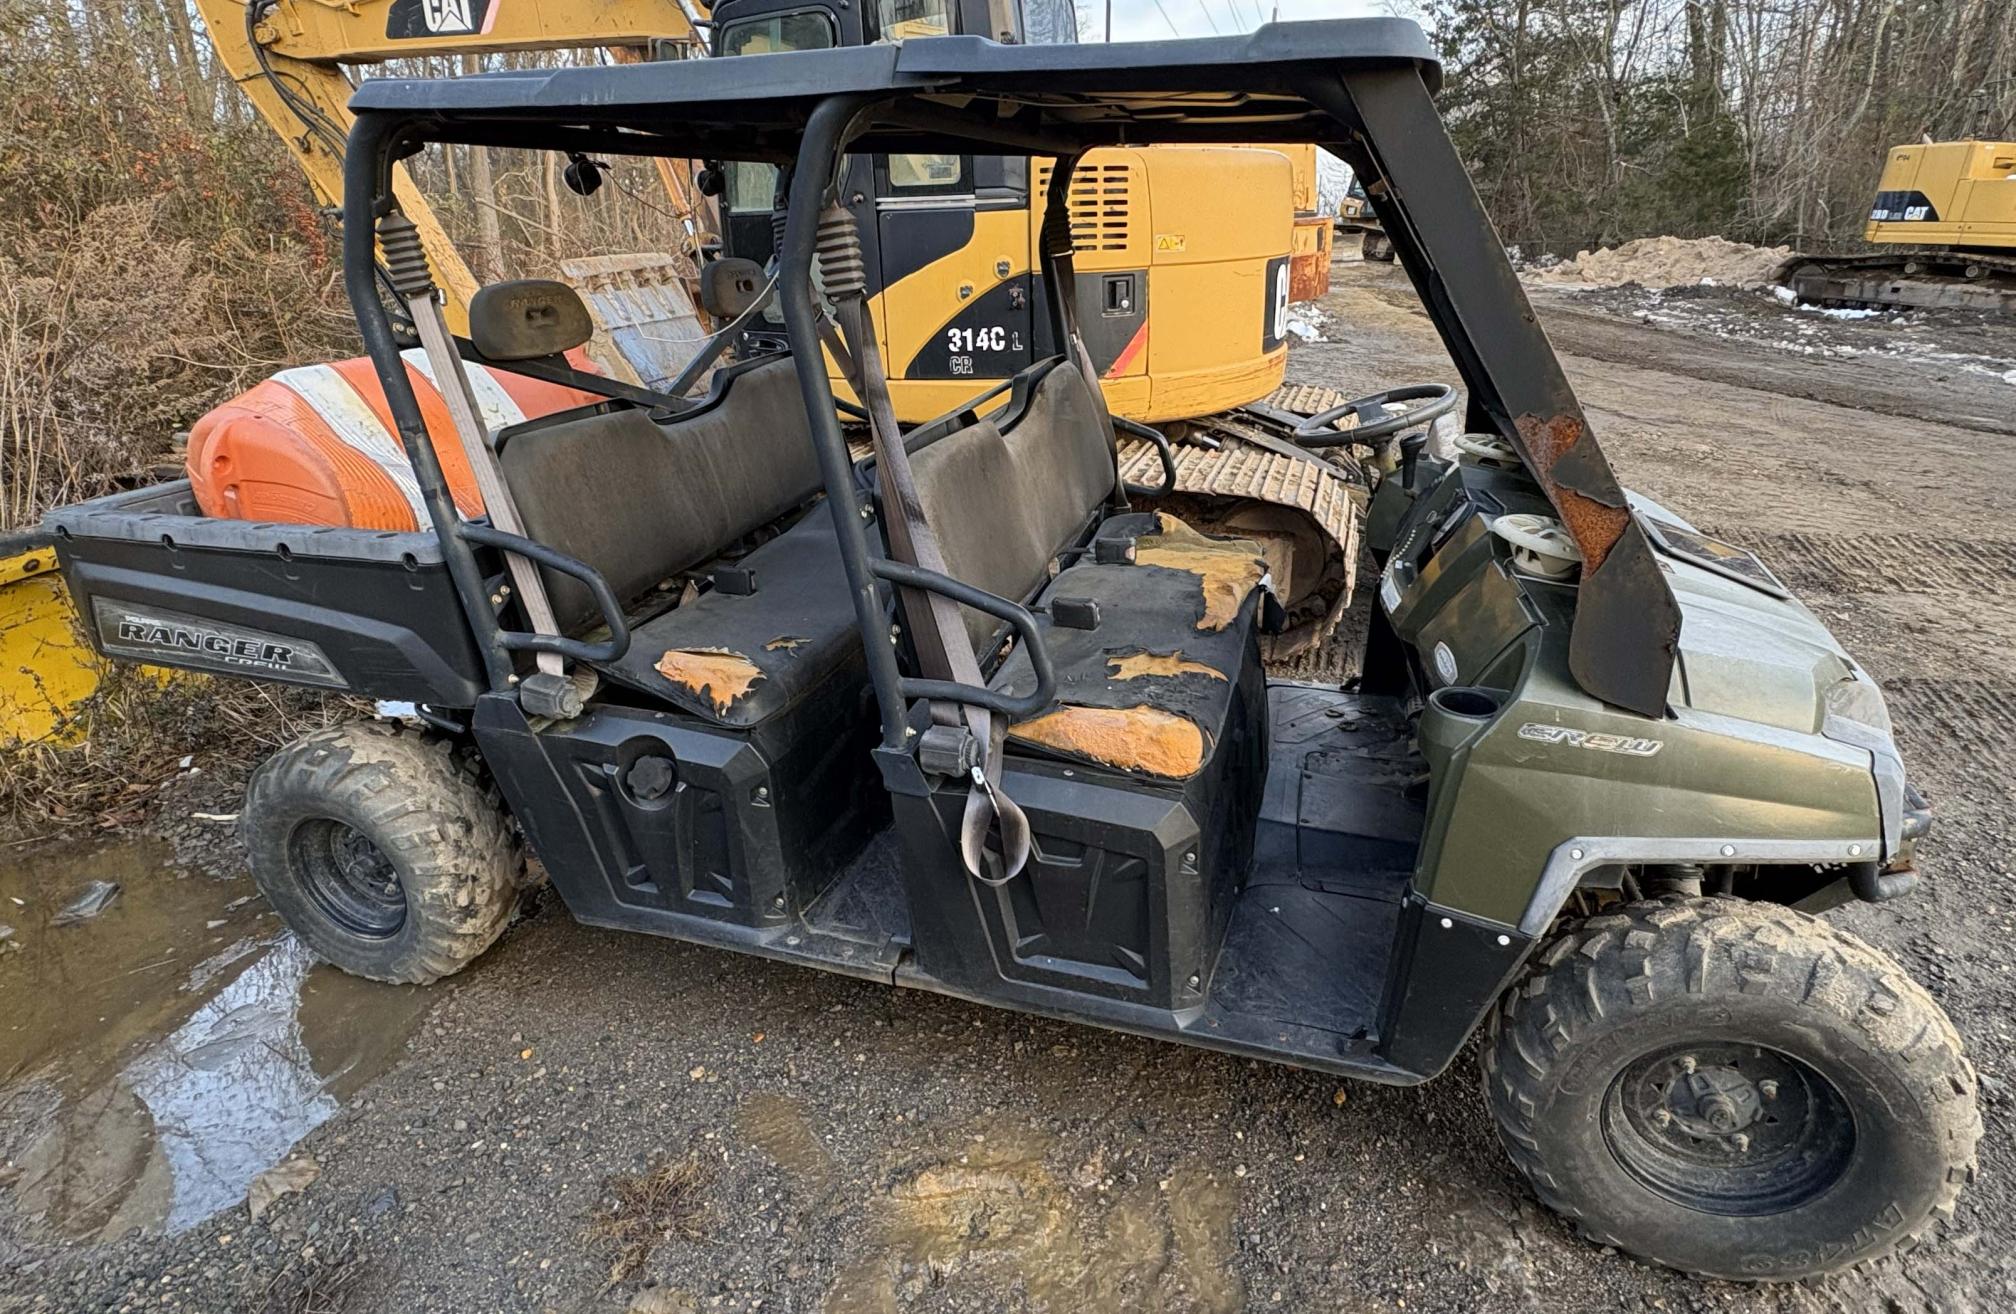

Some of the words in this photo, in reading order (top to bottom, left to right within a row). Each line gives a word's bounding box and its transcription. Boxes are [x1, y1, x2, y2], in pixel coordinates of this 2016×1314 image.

[422, 0, 473, 32] CAT
[1903, 206, 1929, 221] CAT
[947, 326, 1006, 353] 314C
[1011, 331, 1024, 351] L
[949, 355, 974, 375] CR
[118, 621, 294, 665] RANGER
[1517, 722, 1664, 758] CREW
